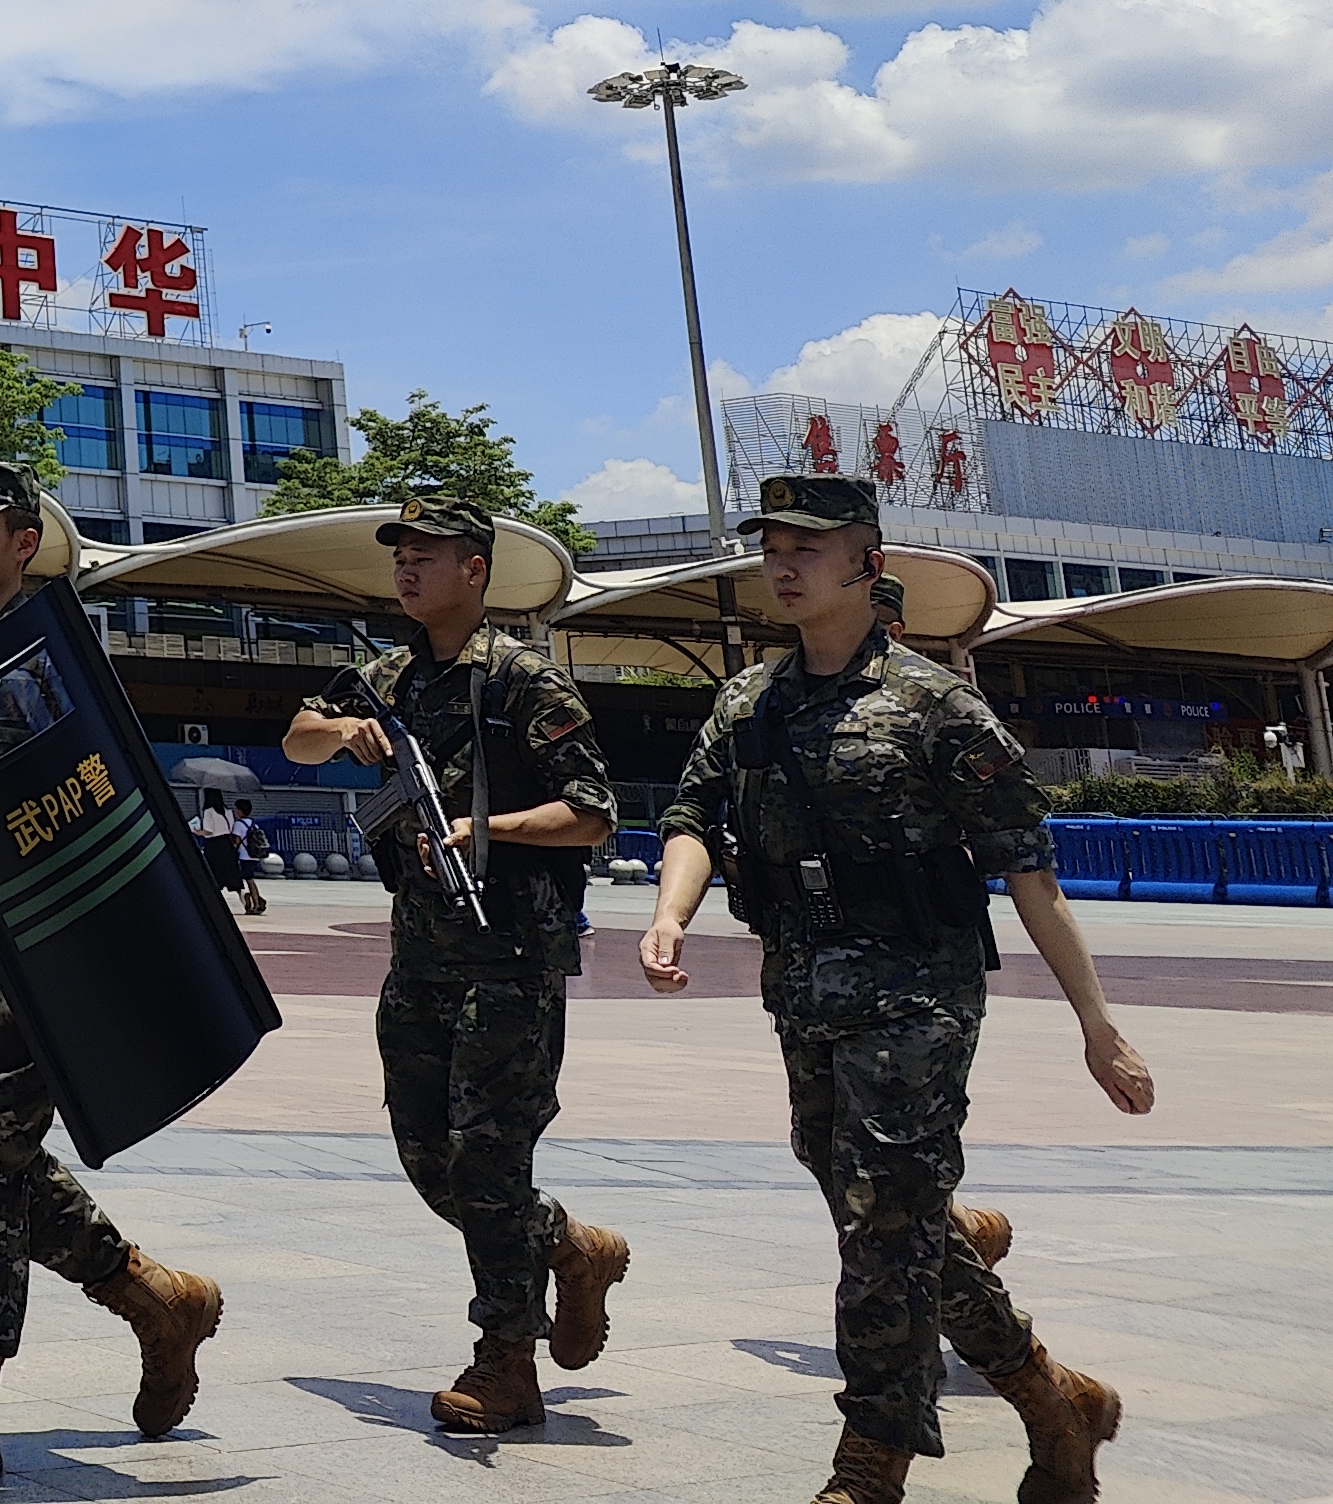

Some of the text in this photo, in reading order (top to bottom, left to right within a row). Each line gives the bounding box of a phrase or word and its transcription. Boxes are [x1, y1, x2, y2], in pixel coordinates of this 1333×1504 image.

[986, 297, 1053, 346] 富强
[1110, 314, 1167, 364] 文明
[1226, 336, 1282, 380] 自由
[994, 362, 1062, 414] 民主
[1122, 379, 1179, 428] 和谐
[1235, 393, 1291, 439] 平等
[1054, 702, 1102, 714] POLICE
[1180, 704, 1211, 718] POLICE
